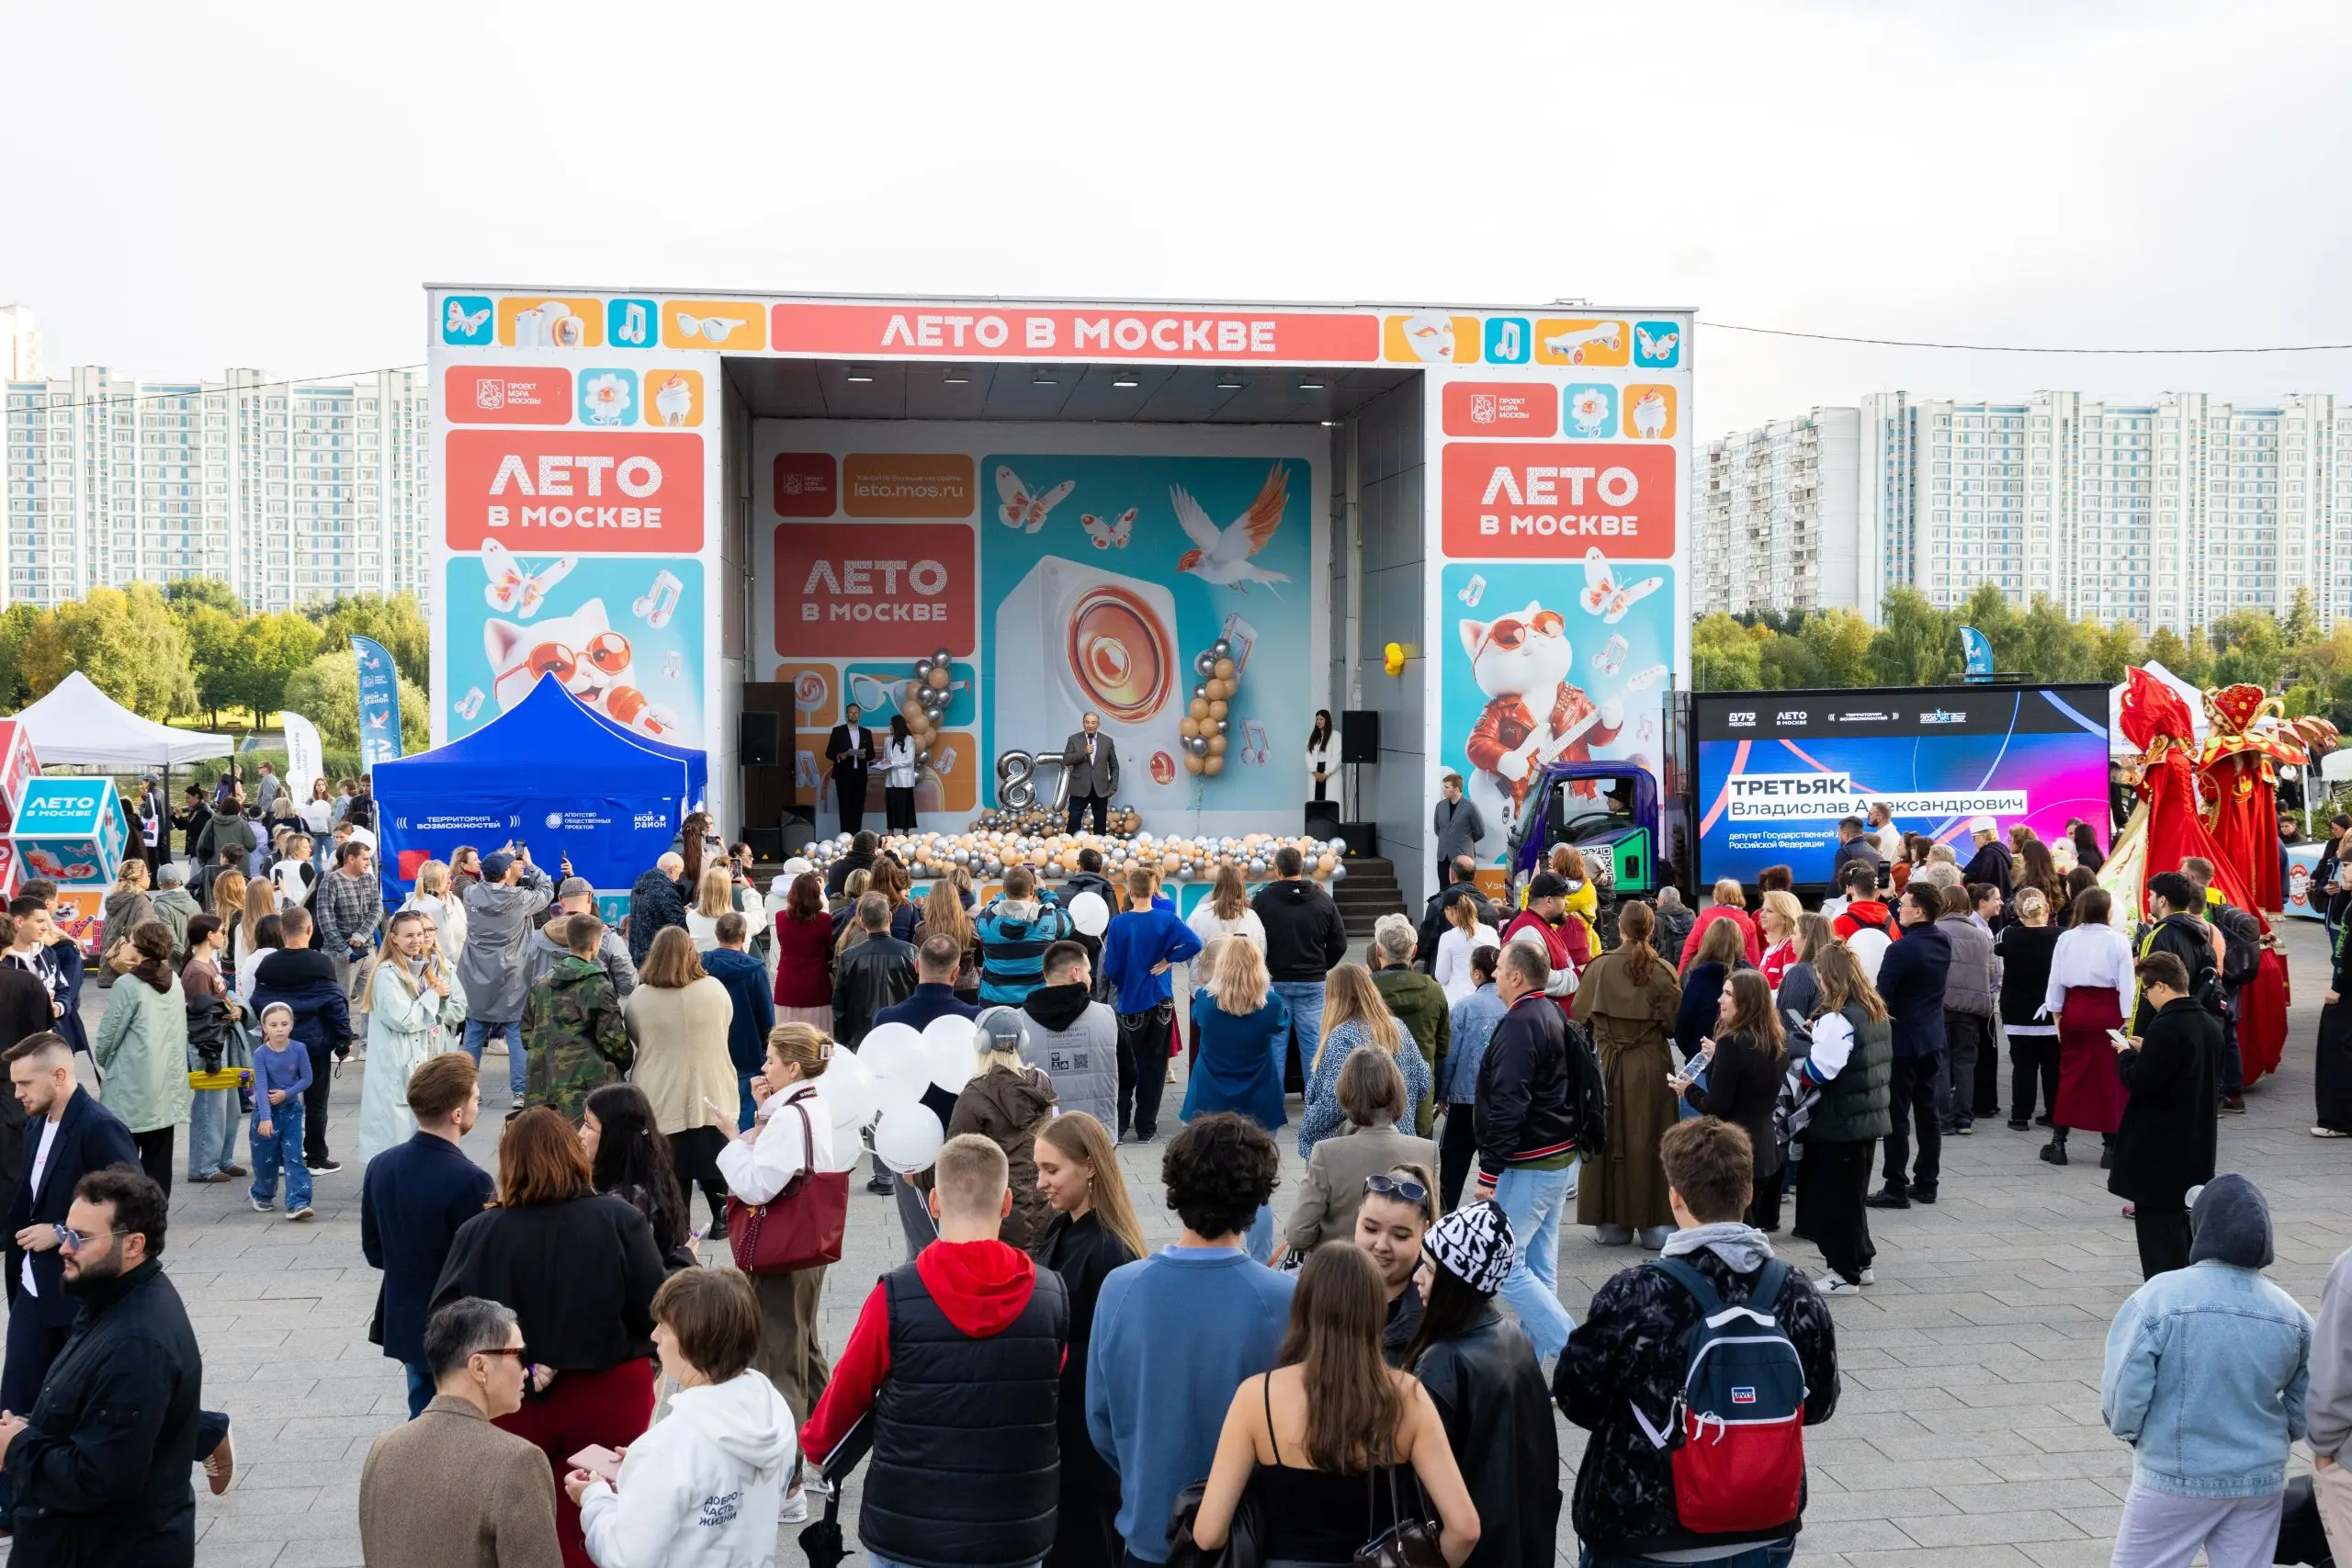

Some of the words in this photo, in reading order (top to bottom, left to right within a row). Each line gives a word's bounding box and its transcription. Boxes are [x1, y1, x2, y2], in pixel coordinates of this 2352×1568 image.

[880, 314, 1009, 348] ЛЕТО
[1025, 317, 1056, 349] В
[1074, 317, 1277, 352] МОСКВЕ
[507, 382, 537, 390] ПРОЕКТ
[507, 389, 530, 398] МЭРА
[507, 397, 542, 405] МОСКВЫ
[488, 454, 662, 499] ЛЕТО
[854, 481, 964, 498] leto.mos.ru
[1480, 466, 1639, 507] ЛЕТО
[488, 505, 510, 527] В
[521, 505, 662, 528] МОСКВЕ
[1480, 514, 1500, 535] В
[1510, 514, 1638, 536] МОСКВЕ
[802, 559, 948, 595] ЛЕТО
[801, 603, 820, 621] В
[829, 603, 947, 621] МОСКВЕ
[1728, 712, 1757, 722] 879
[1776, 711, 1808, 720] ЛЕТО
[1731, 778, 1848, 796] ТРЕТЬЯК
[28, 796, 96, 809] ЛЕТО
[1732, 800, 1850, 817] Владислав
[1854, 797, 2024, 814] Аександрович
[416, 819, 501, 829] ВОЗМОЖНОСТЕЙ
[1728, 831, 1761, 841] депутат
[1763, 830, 1835, 840] Государственной
[1728, 840, 1778, 850] Российской
[1778, 840, 1826, 850] Федерации
[704, 1491, 738, 1506] ДОБРО
[703, 1504, 734, 1517] ЧАСТЬ
[698, 1511, 737, 1527] ЖИЗНИ
